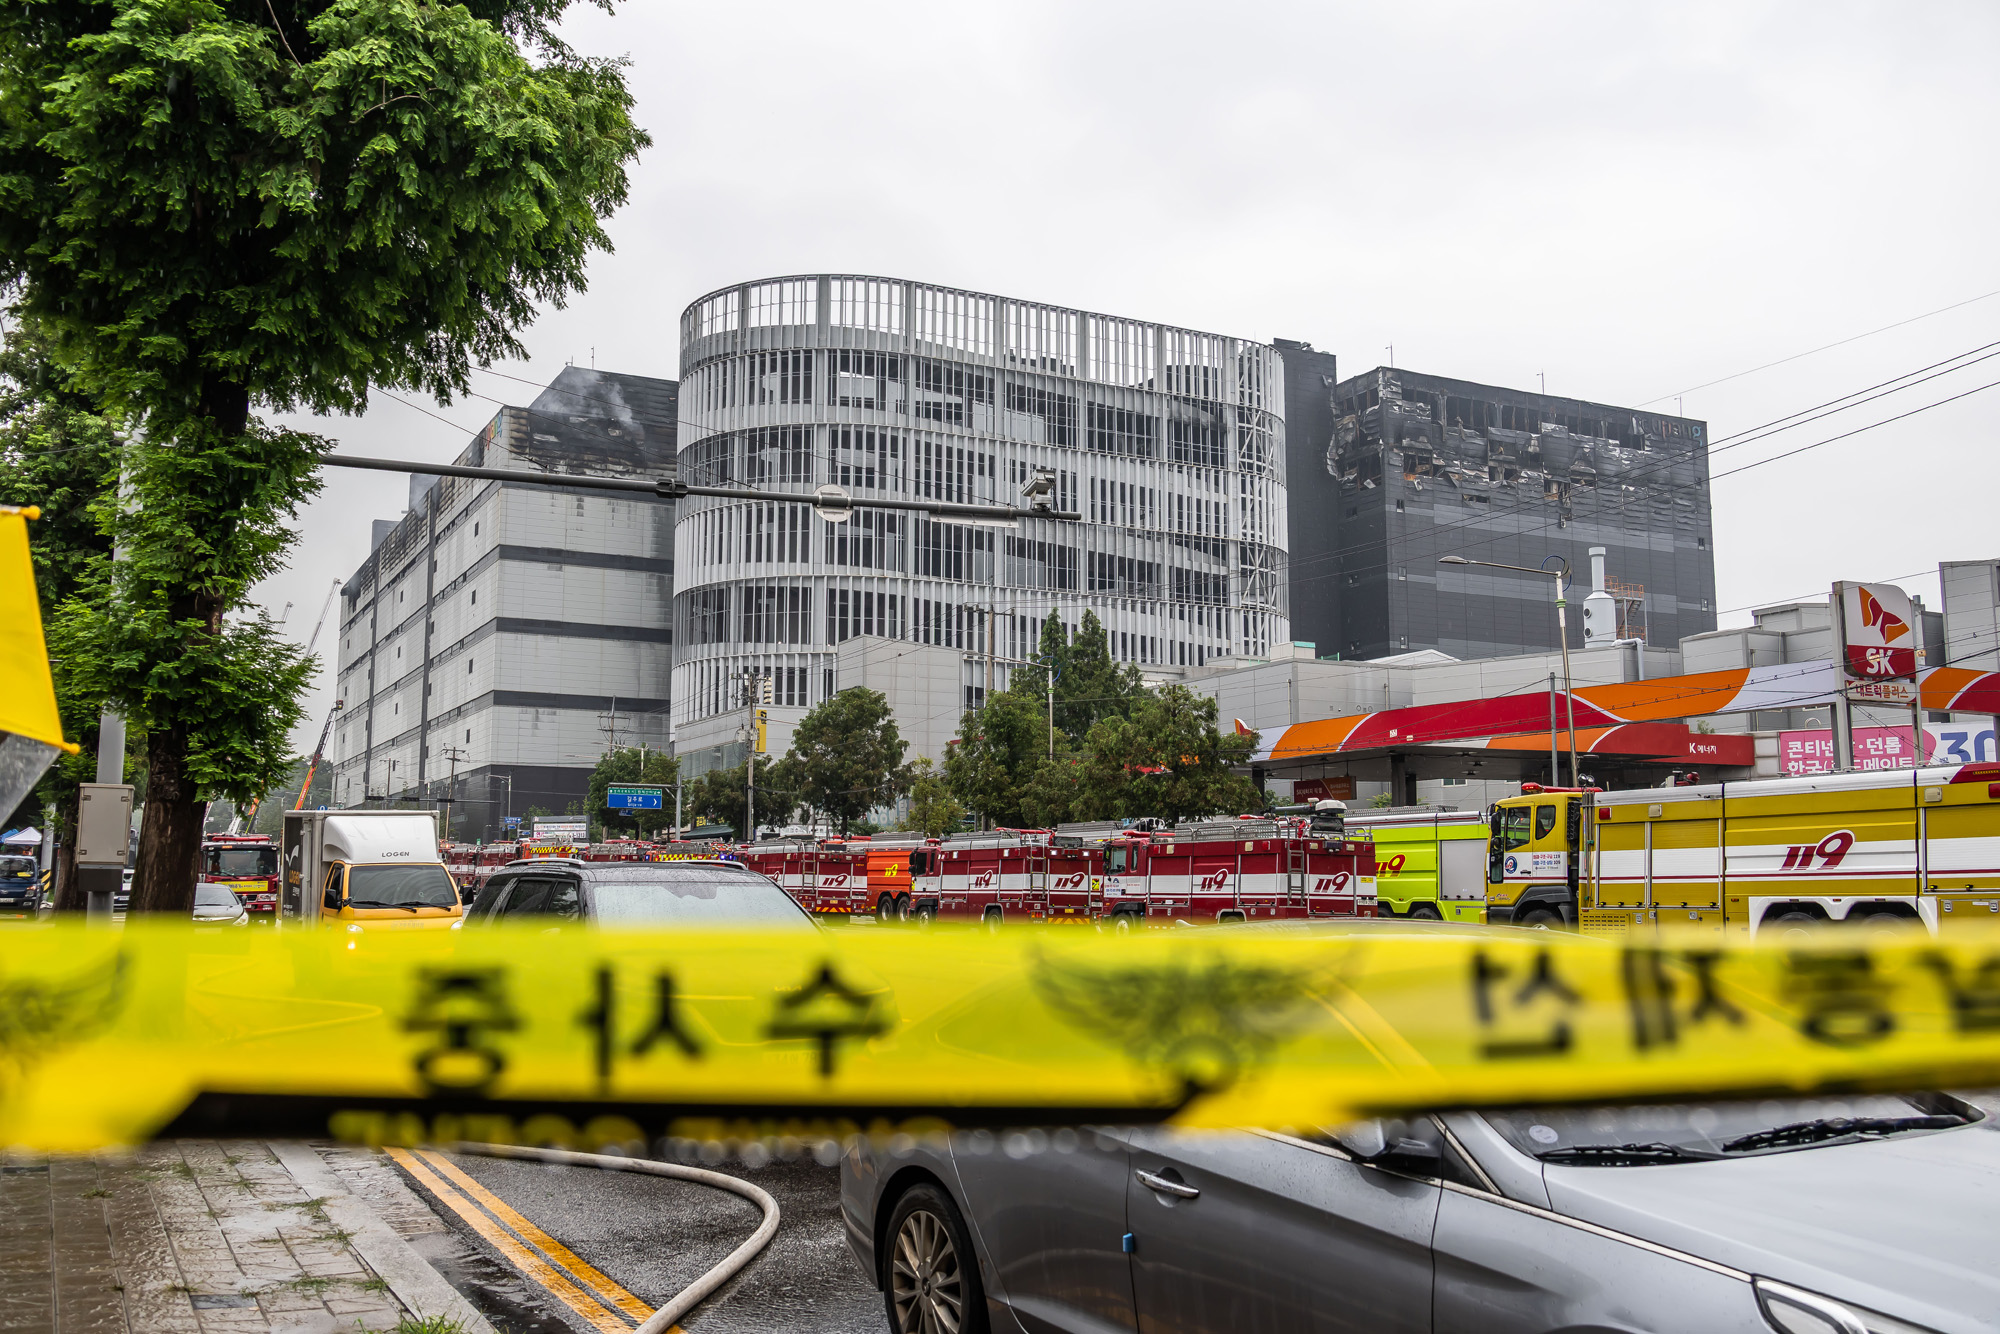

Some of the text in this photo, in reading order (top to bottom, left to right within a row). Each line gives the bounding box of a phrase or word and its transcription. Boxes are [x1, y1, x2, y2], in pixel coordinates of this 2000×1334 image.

[1865, 647, 1896, 675] SK
[1855, 684, 1909, 699] 내트럭플러스
[1779, 829, 1855, 871] 119
[822, 873, 848, 887] 119
[884, 863, 899, 878] 119
[974, 869, 993, 889] 119
[1199, 868, 1229, 892] 119
[1054, 872, 1086, 890] 119
[1313, 871, 1350, 893] 119
